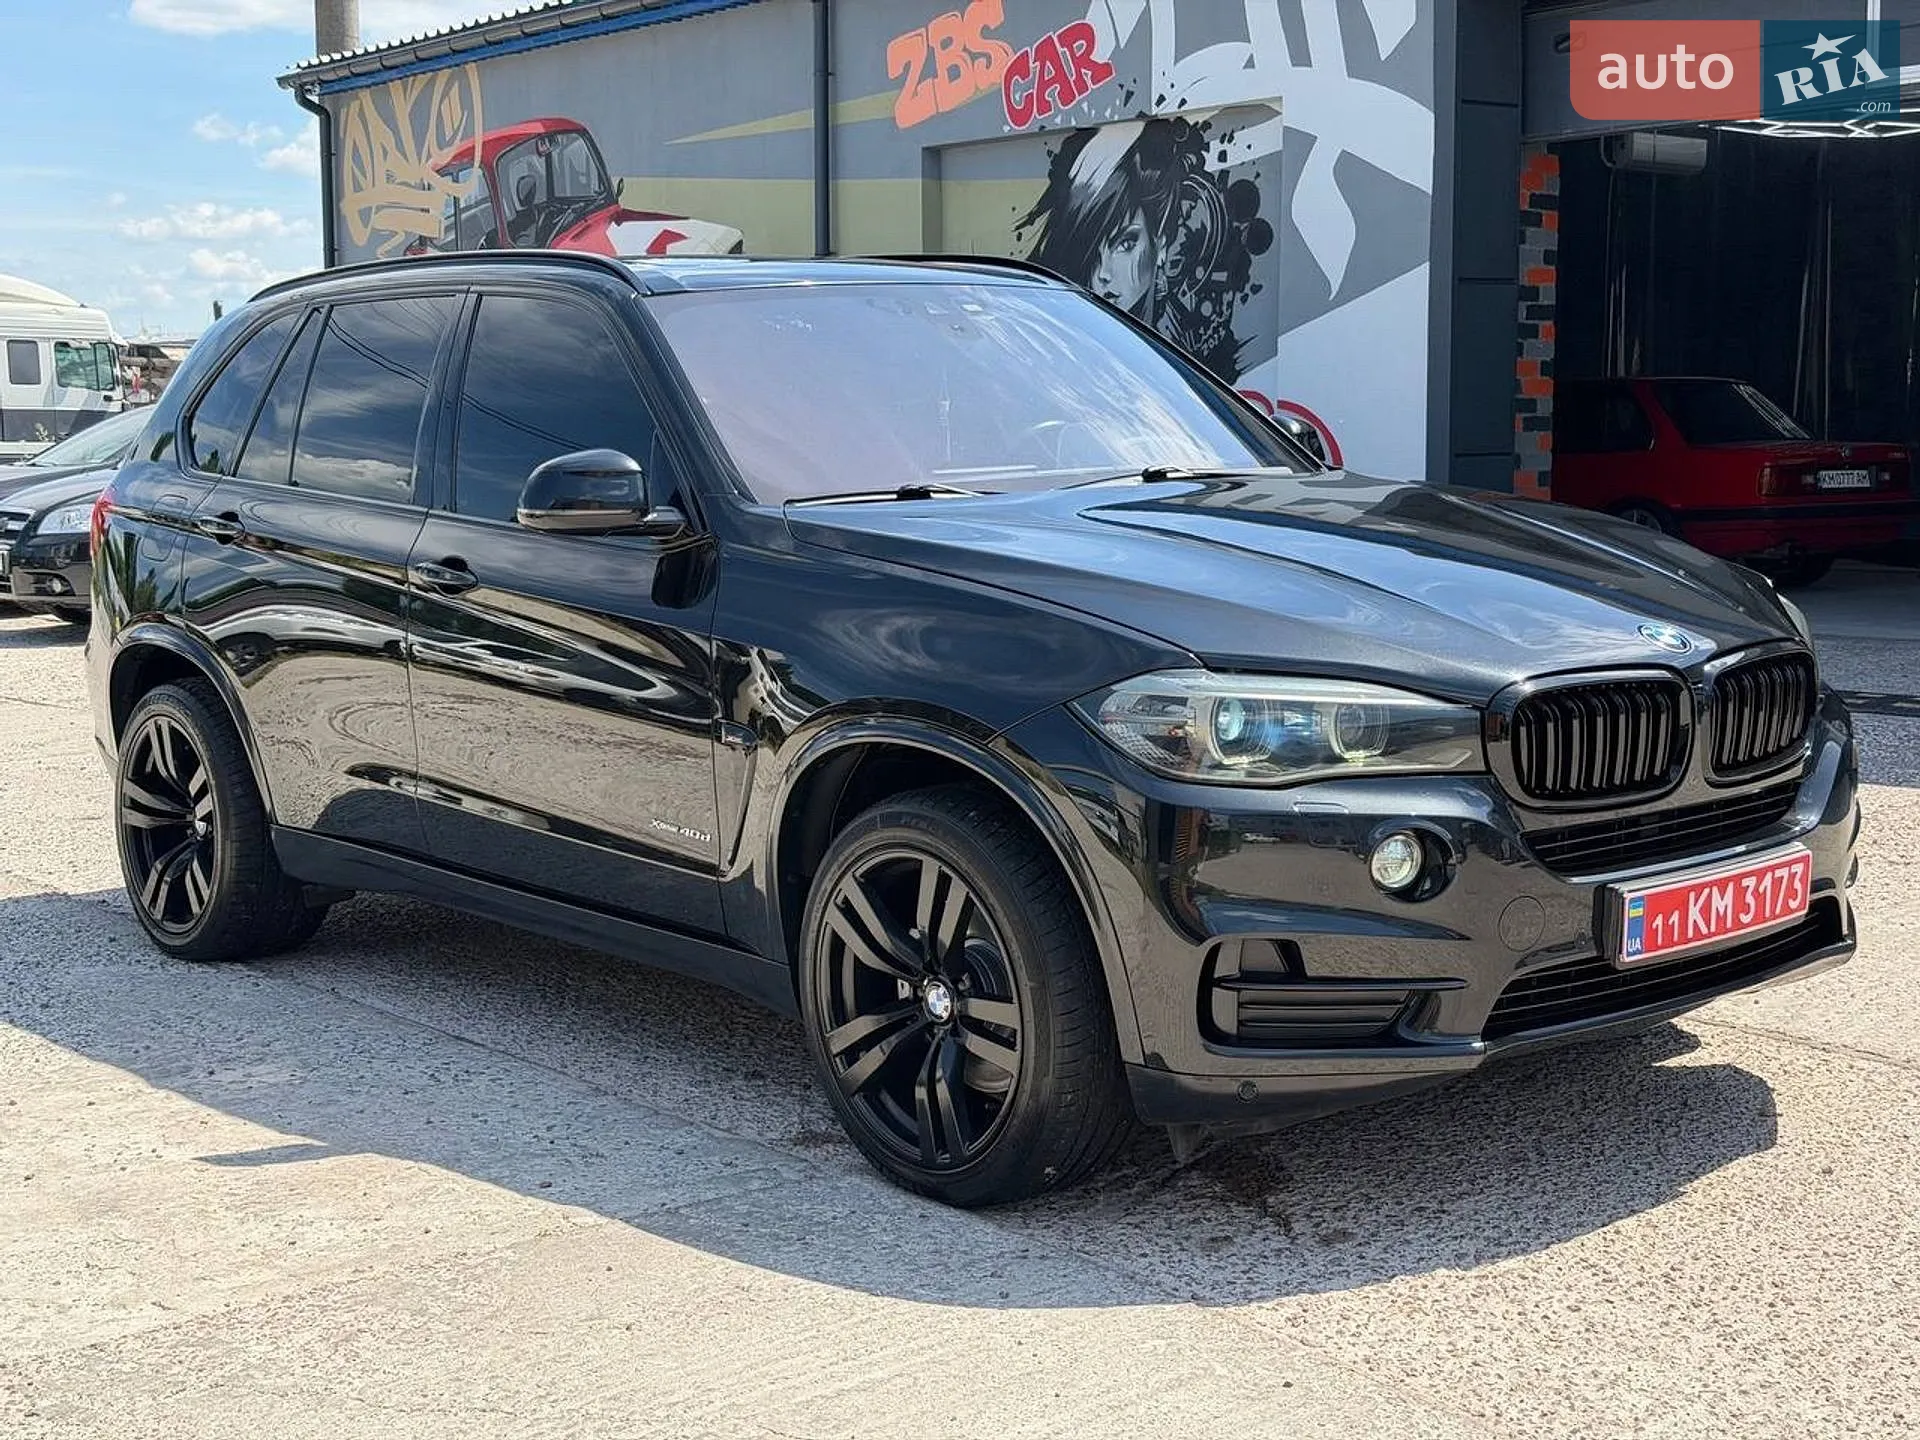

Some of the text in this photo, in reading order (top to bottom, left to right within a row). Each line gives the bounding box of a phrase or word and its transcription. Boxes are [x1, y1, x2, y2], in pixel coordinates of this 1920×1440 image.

[887, 0, 1015, 128] ZBS
[1002, 19, 1116, 130] CAR
[1627, 938, 1642, 952] UA
[1652, 862, 1805, 946] 11 KM 3173
